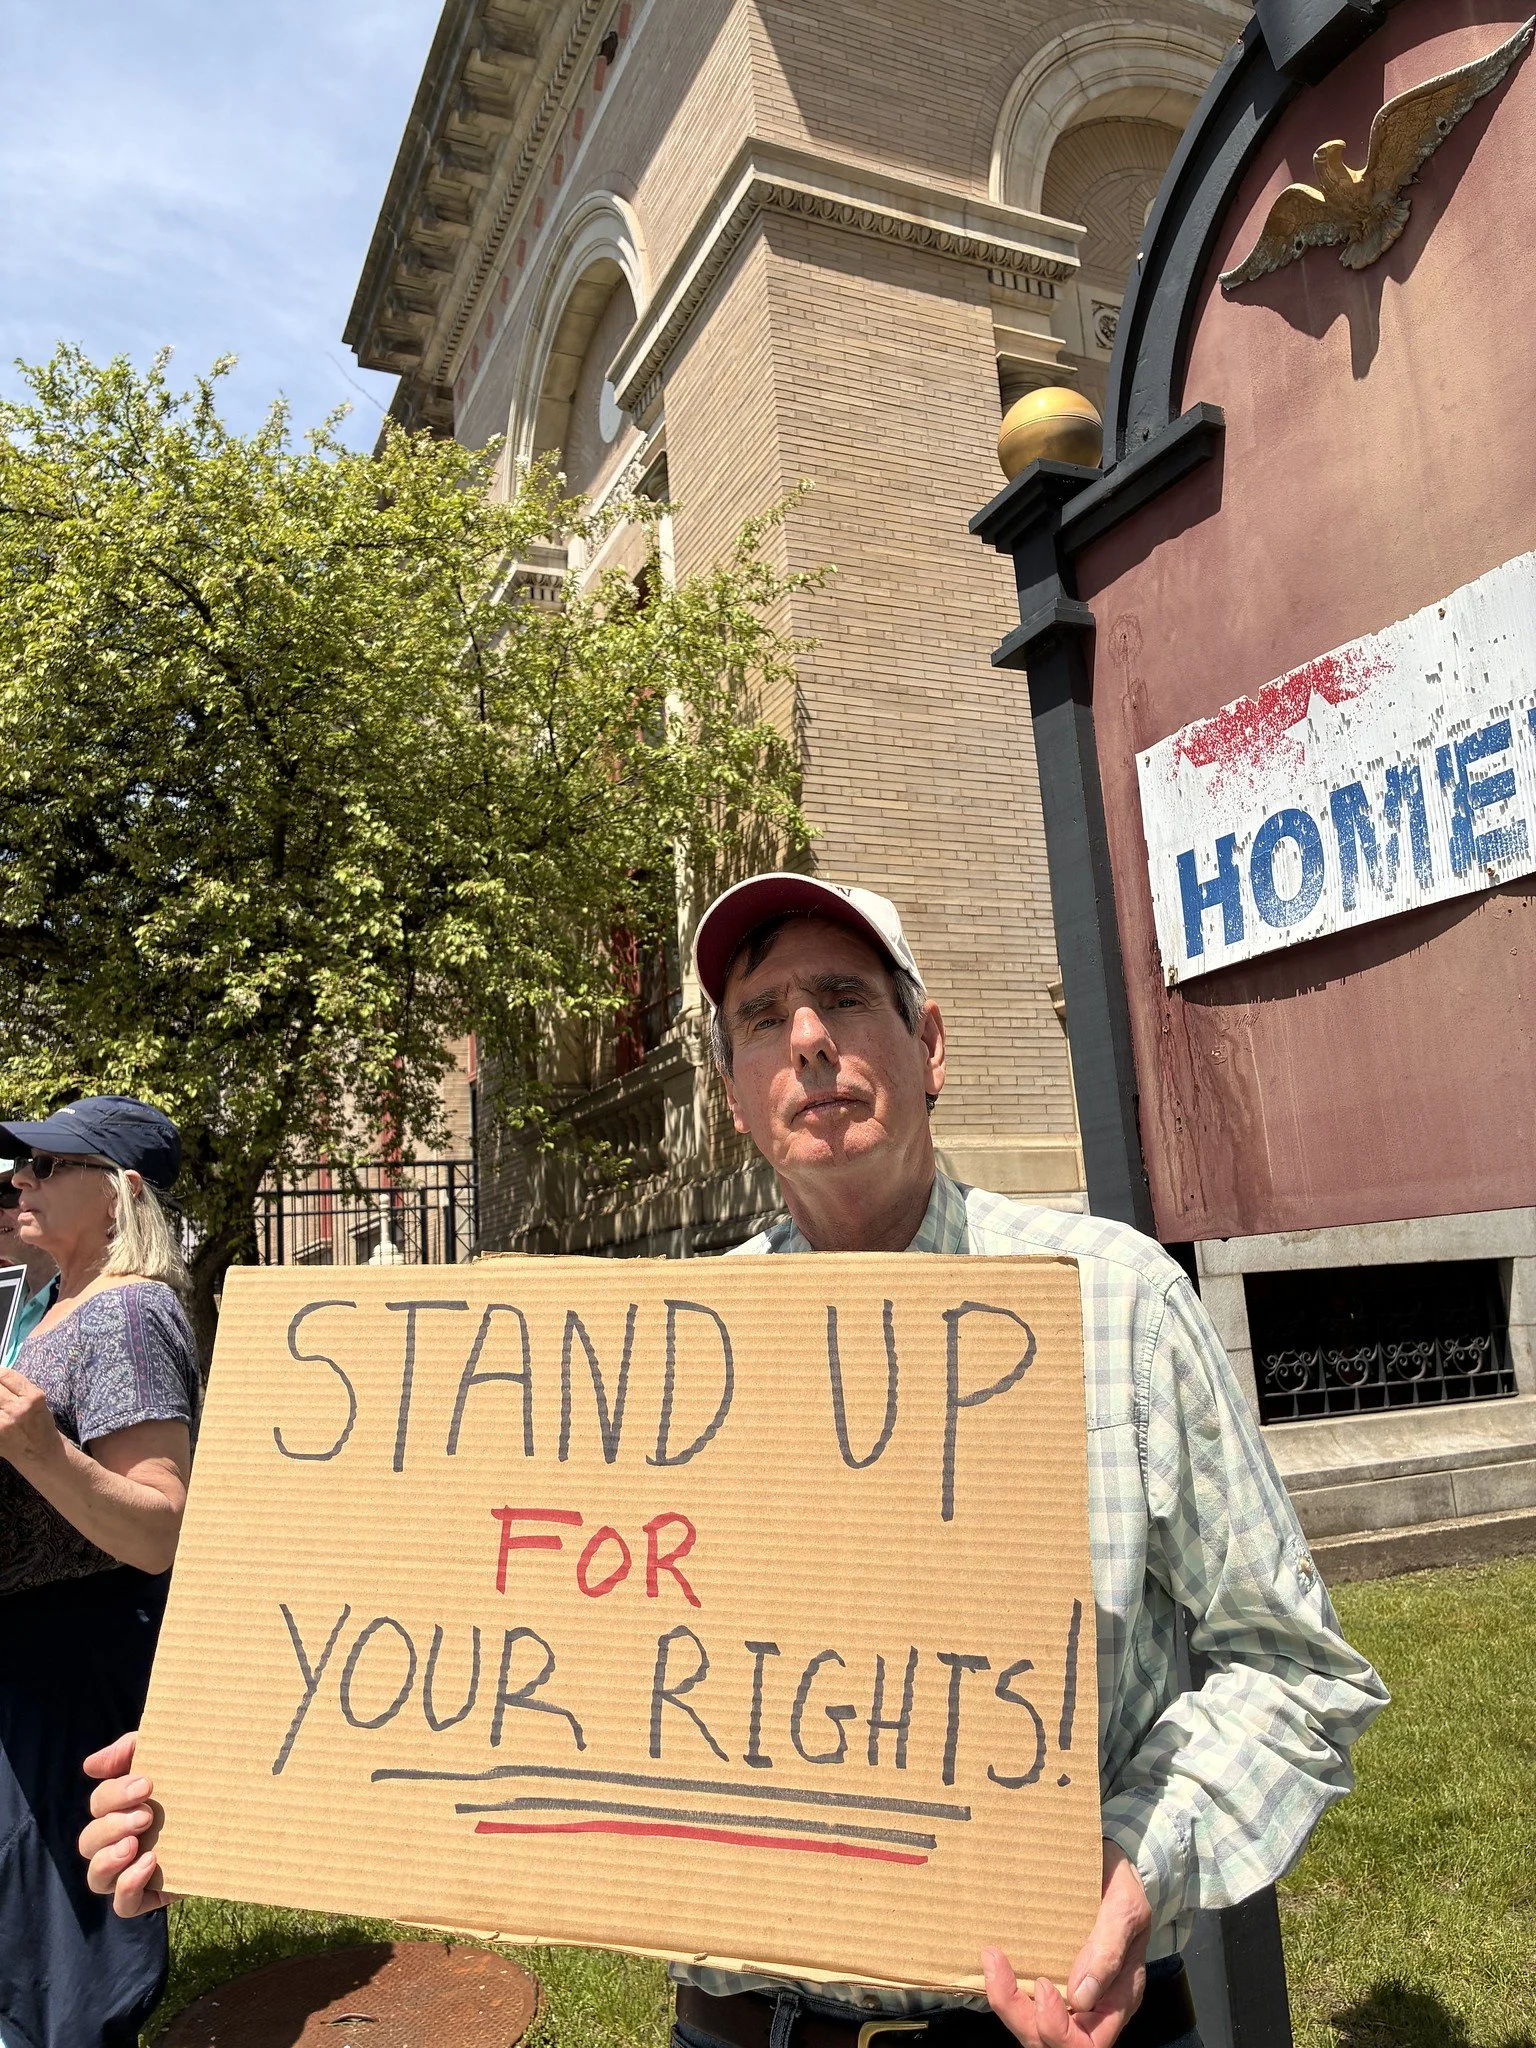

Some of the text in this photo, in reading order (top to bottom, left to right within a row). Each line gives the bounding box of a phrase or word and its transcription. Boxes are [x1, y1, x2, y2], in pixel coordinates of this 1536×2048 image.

[1177, 706, 1536, 959] HOME
[274, 1299, 1037, 1521] STAND UP
[491, 1506, 702, 1608] FOR
[273, 1600, 1083, 1788] YOUR RIGHTS!
